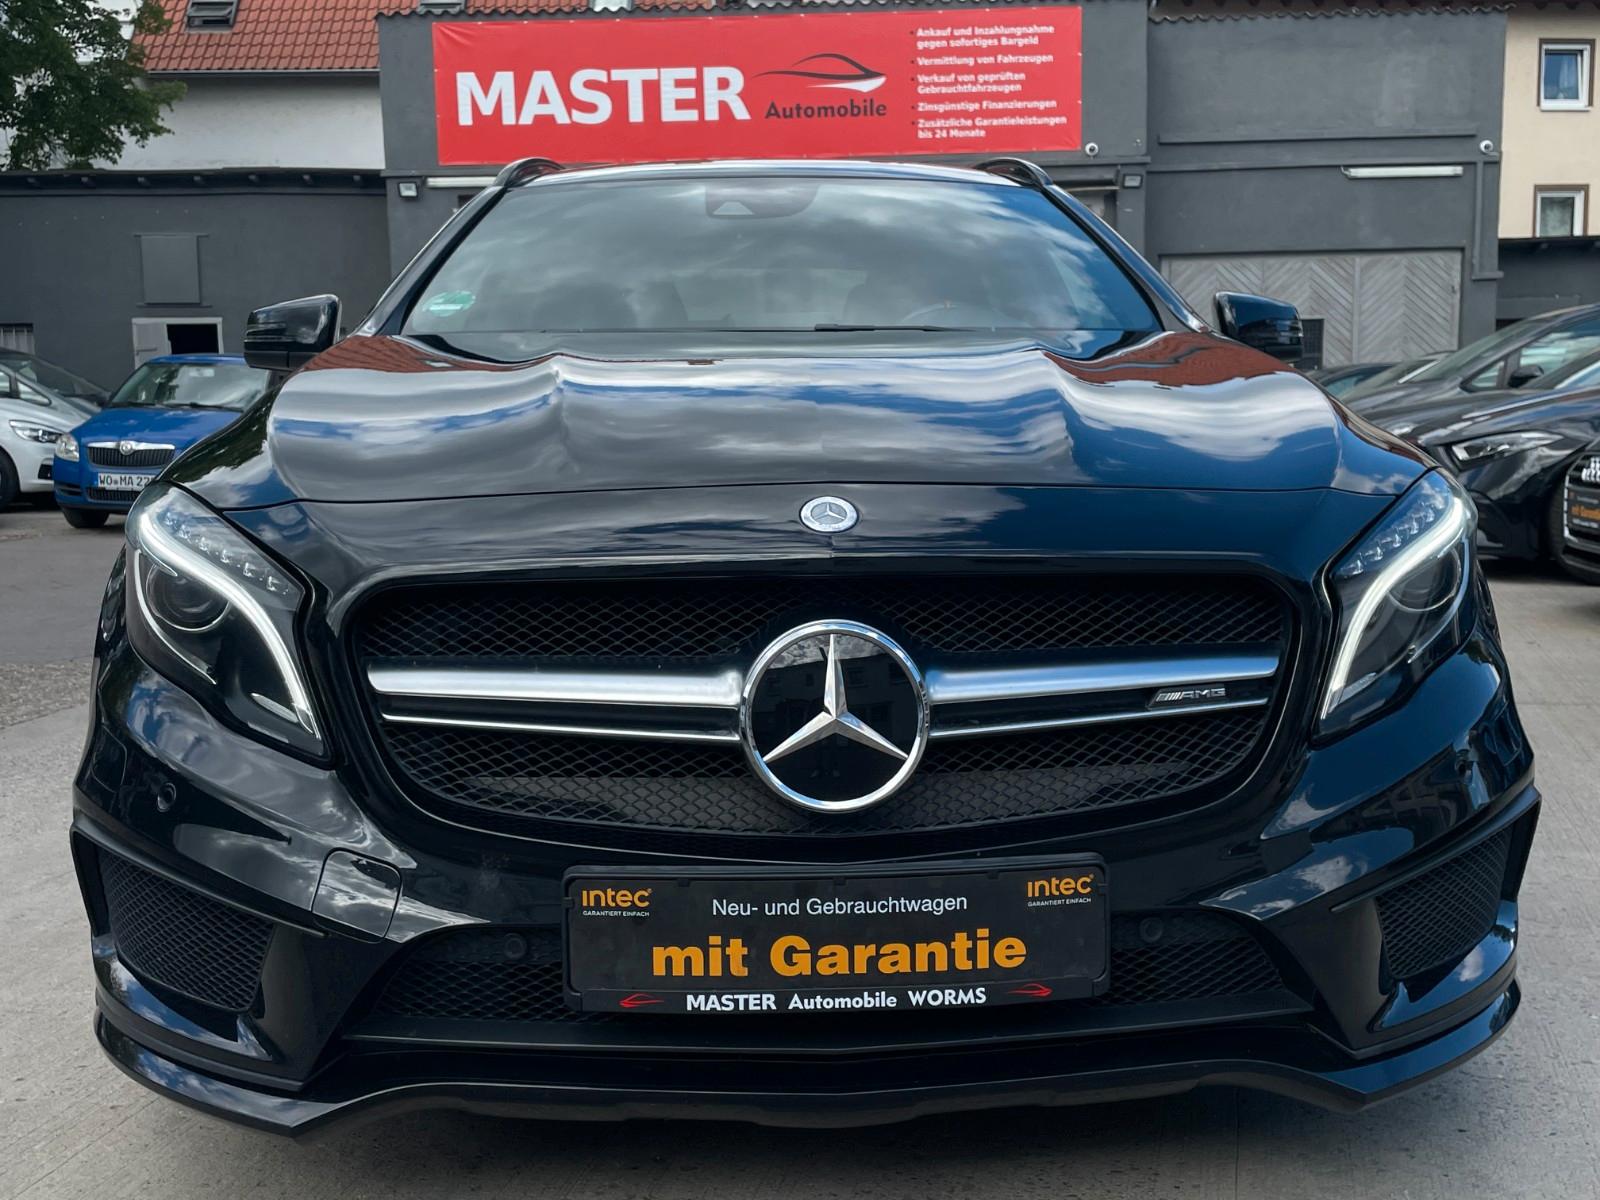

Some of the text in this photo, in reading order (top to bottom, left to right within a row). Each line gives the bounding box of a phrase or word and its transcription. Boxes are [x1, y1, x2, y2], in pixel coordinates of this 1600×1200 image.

[917, 25, 1055, 37] Ankauf und Inzahlungnahme
[917, 36, 1039, 50] gegen sofortiges Bargeld
[918, 56, 975, 66] Vermittlung
[997, 54, 1053, 64] Fahrzeugen
[918, 71, 1026, 83] Verkauf von geprüften
[918, 83, 1022, 94] Gebrauchtfahrzeugen
[456, 66, 751, 126] MASTER
[765, 98, 887, 119] Automobile
[918, 100, 1057, 112] Zinsgünstige Finanzierungen
[918, 116, 1067, 128] Zusätzliche Garantieleistungen
[918, 129, 986, 138] bis 24 Monate
[100, 475, 113, 485] WO
[120, 476, 134, 486] MA
[1179, 688, 1225, 699] AMG
[712, 896, 968, 916] Neu- und Gebrauchtwagen
[1027, 897, 1091, 907] GARANTIERT EINFACH
[652, 928, 1027, 977] mit Garantie
[686, 987, 987, 1011] MASTER Automobile WORMS
